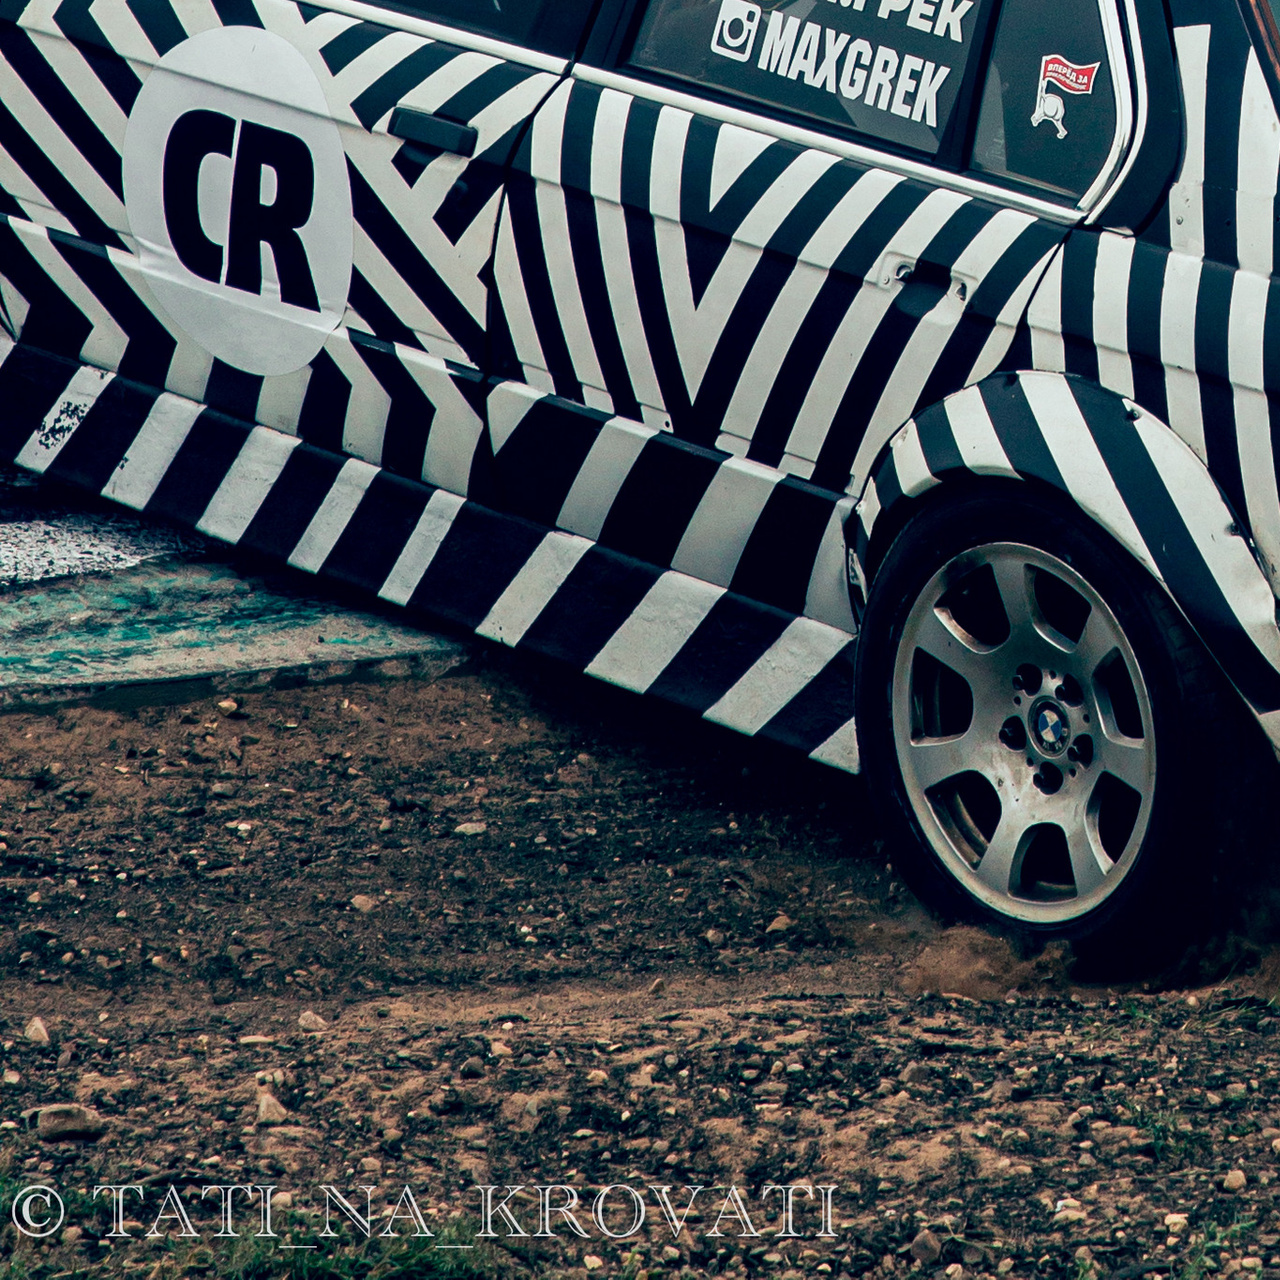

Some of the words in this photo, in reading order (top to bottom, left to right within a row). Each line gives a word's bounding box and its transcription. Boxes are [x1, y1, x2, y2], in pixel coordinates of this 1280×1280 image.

[757, 11, 951, 128] MAXGREK
[1047, 62, 1077, 83] ВПЕРЁД
[1077, 74, 1088, 84] ЗА
[162, 108, 322, 313] CR
